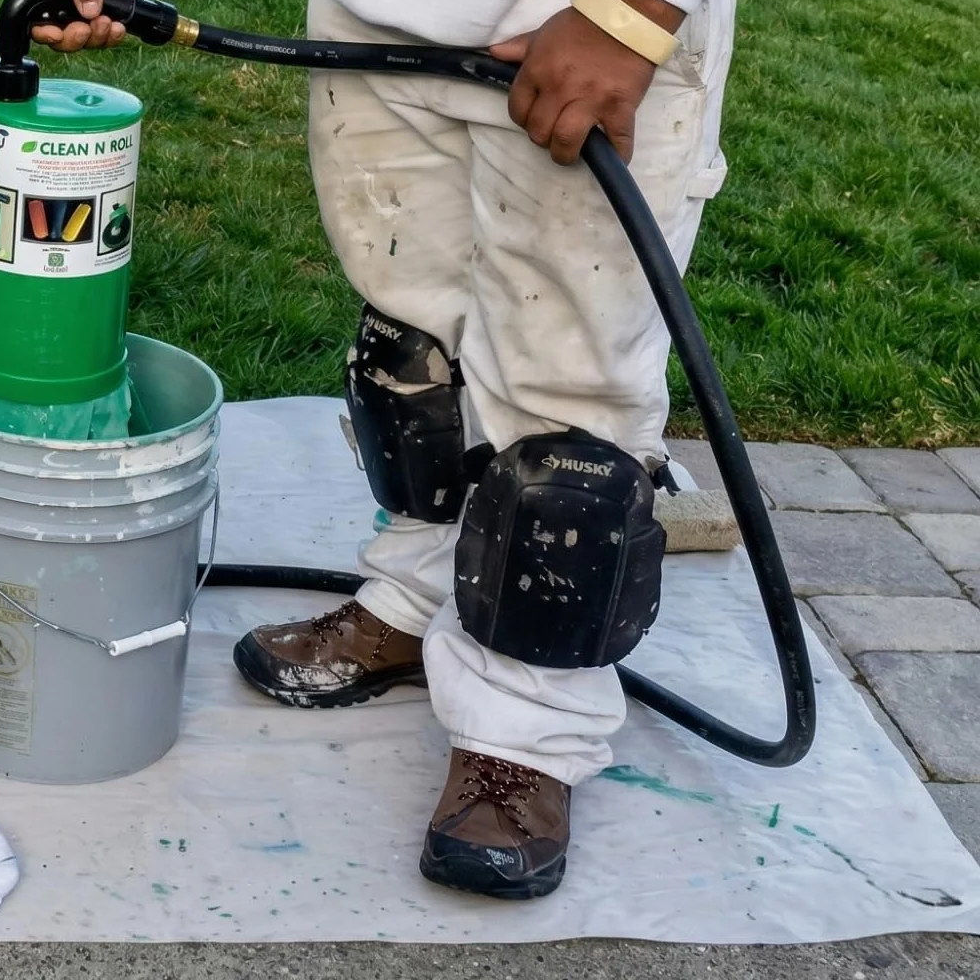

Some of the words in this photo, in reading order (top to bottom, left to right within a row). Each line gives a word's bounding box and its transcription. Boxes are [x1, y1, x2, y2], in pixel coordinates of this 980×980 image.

[40, 142, 88, 156] CLEAN
[95, 141, 106, 155] N
[110, 135, 133, 153] ROLL
[561, 458, 612, 477] HUSKY
